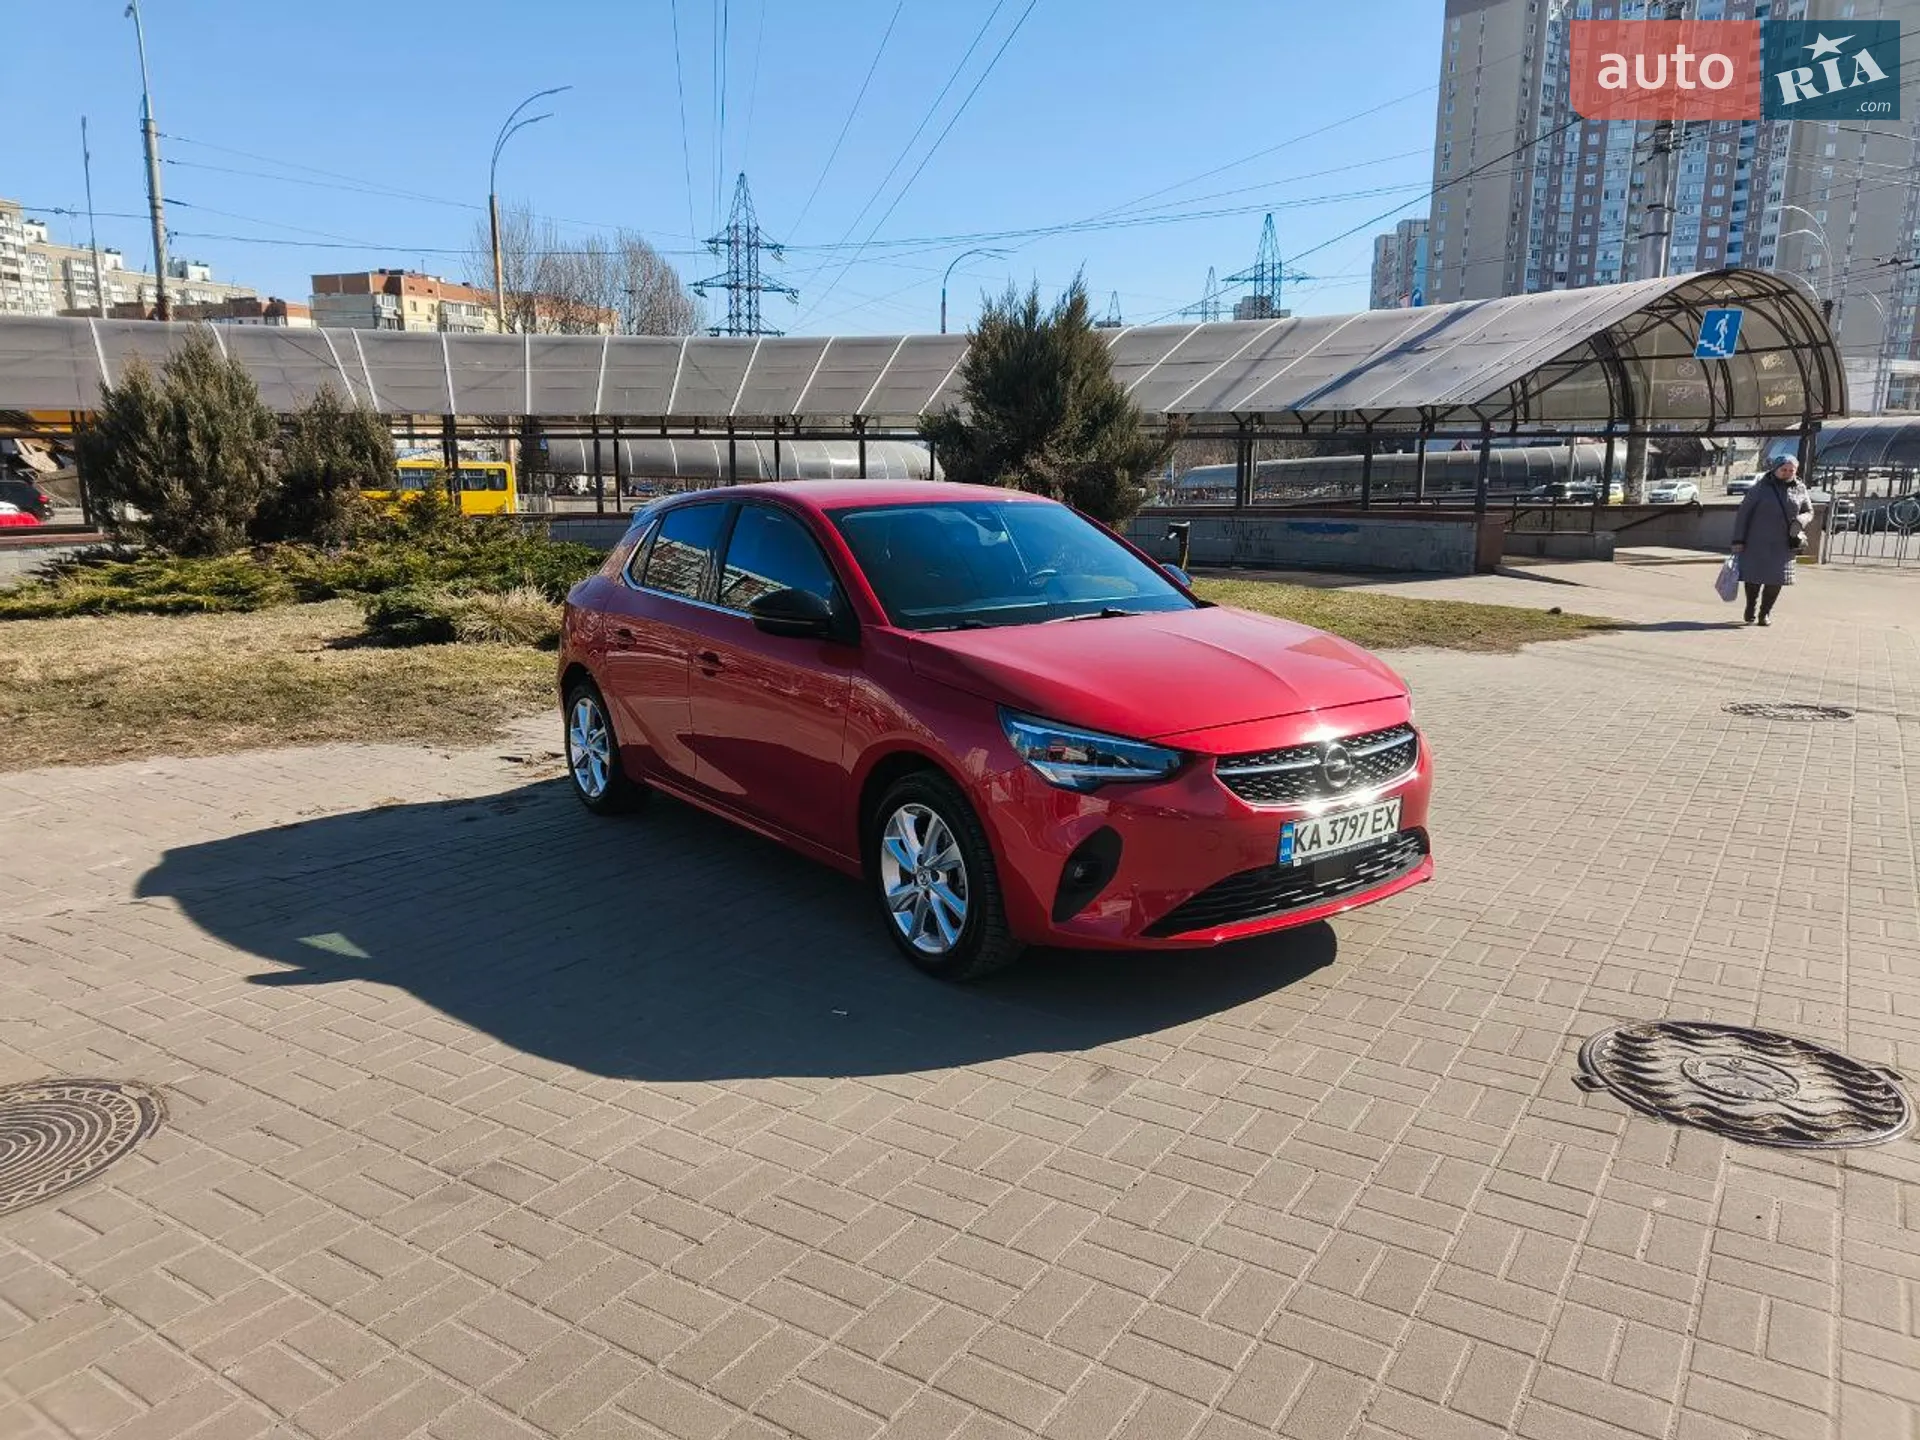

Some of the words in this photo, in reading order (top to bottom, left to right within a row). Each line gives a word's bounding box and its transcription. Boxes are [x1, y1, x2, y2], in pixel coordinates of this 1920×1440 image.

[1294, 824, 1322, 854] KA
[1327, 811, 1369, 846] 3797
[1371, 804, 1397, 834] EX
